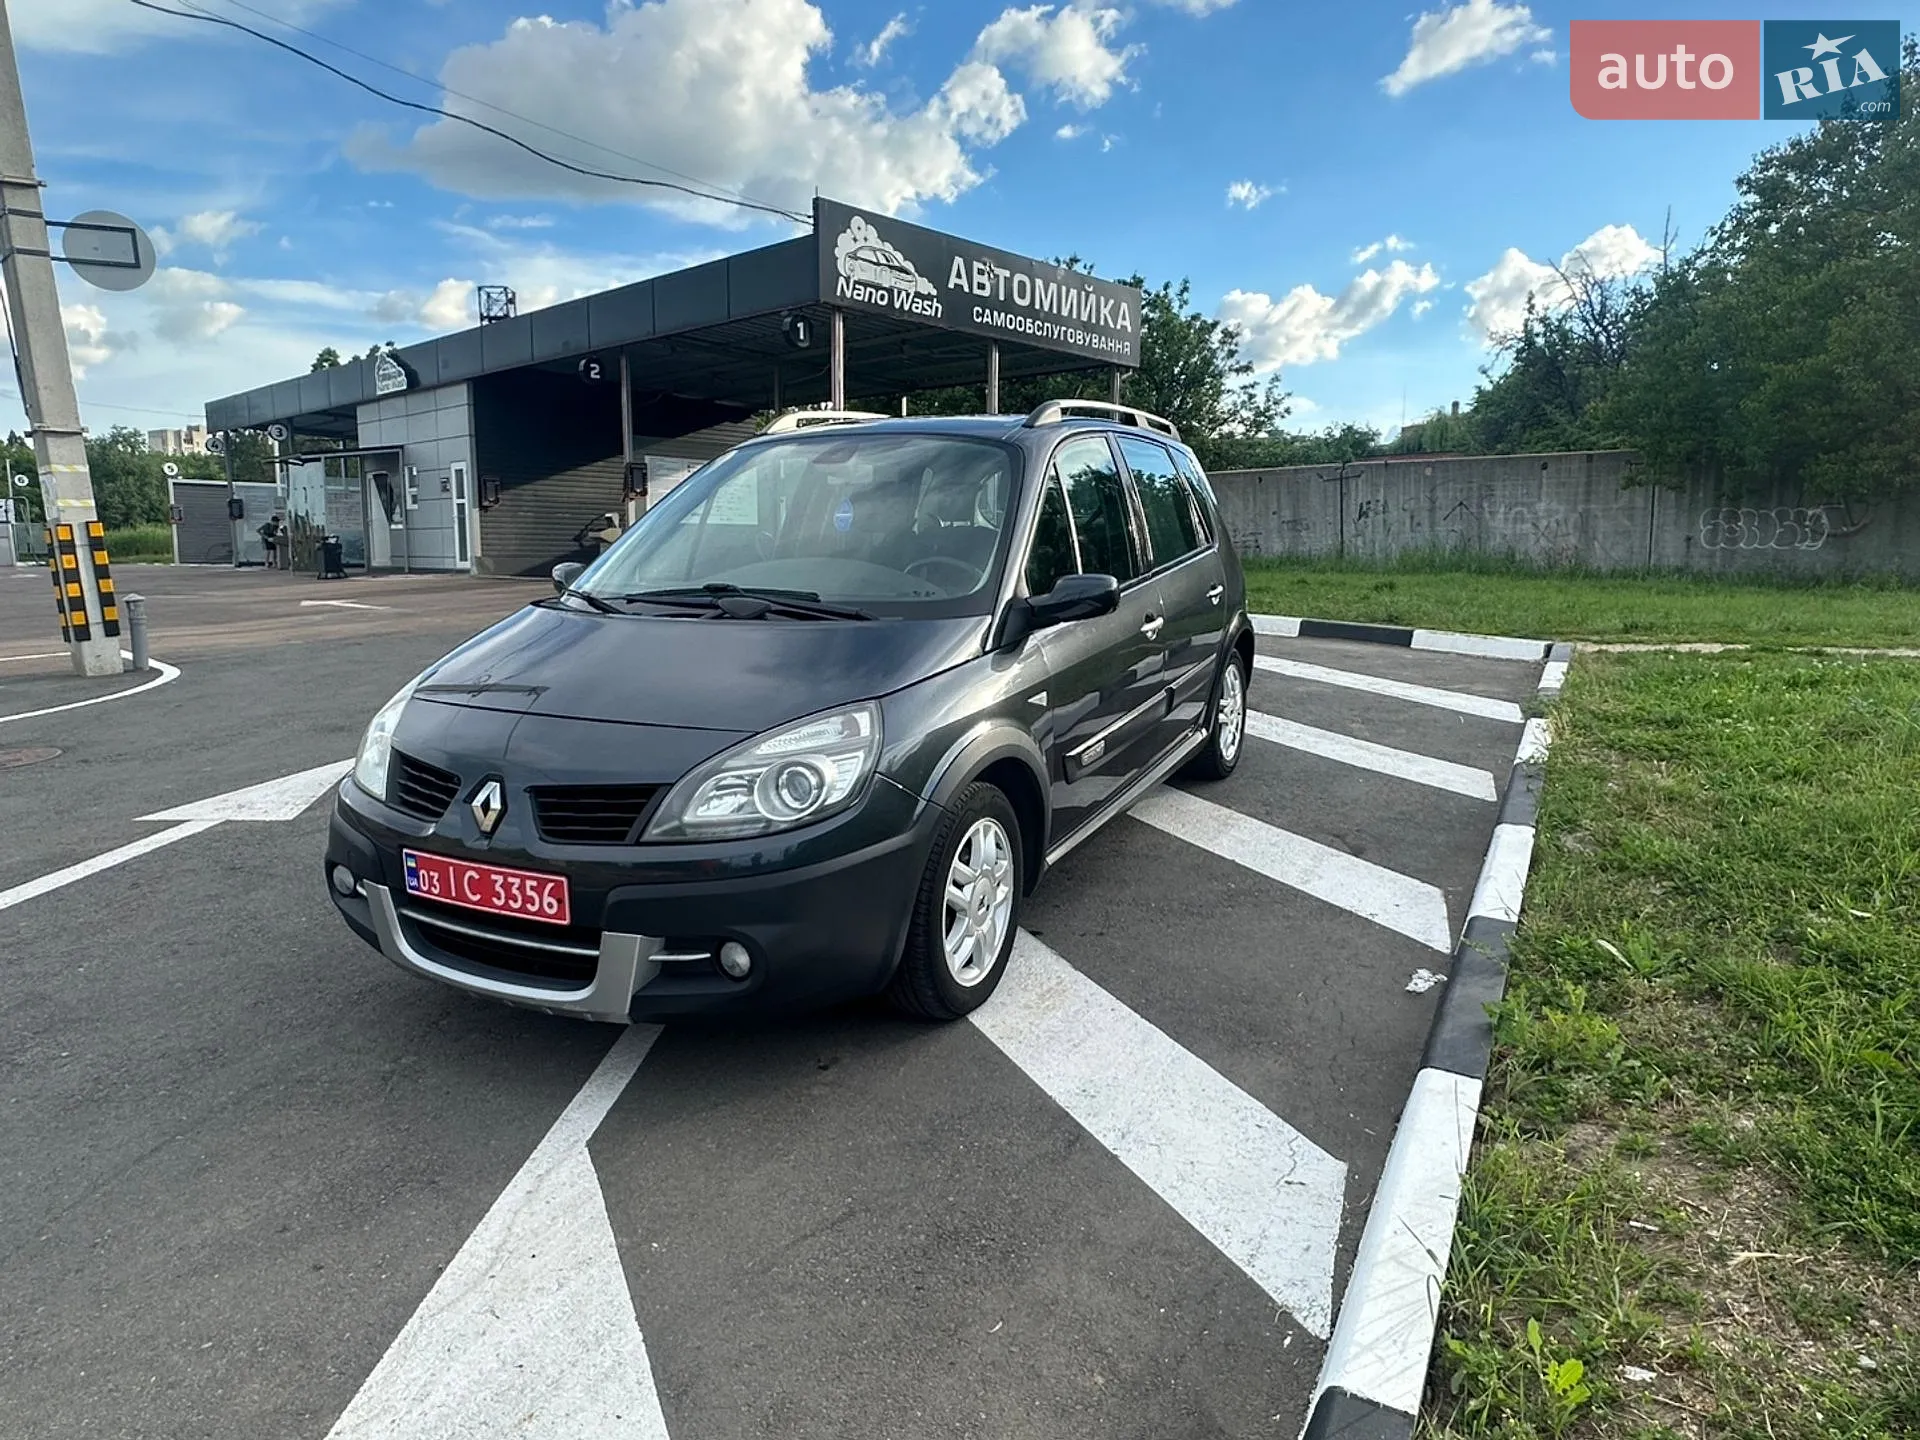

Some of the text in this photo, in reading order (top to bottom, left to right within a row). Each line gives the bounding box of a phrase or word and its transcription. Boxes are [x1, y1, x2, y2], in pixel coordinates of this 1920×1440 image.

[836, 276, 943, 319] Nano Wash
[947, 255, 1132, 333] АВТОМИЙКА
[796, 321, 804, 340] 1
[973, 306, 1131, 356] САМООБСЛУГОВУВАННЯ
[589, 363, 600, 379] 2
[419, 868, 441, 895] 03
[490, 873, 559, 915] 3356
